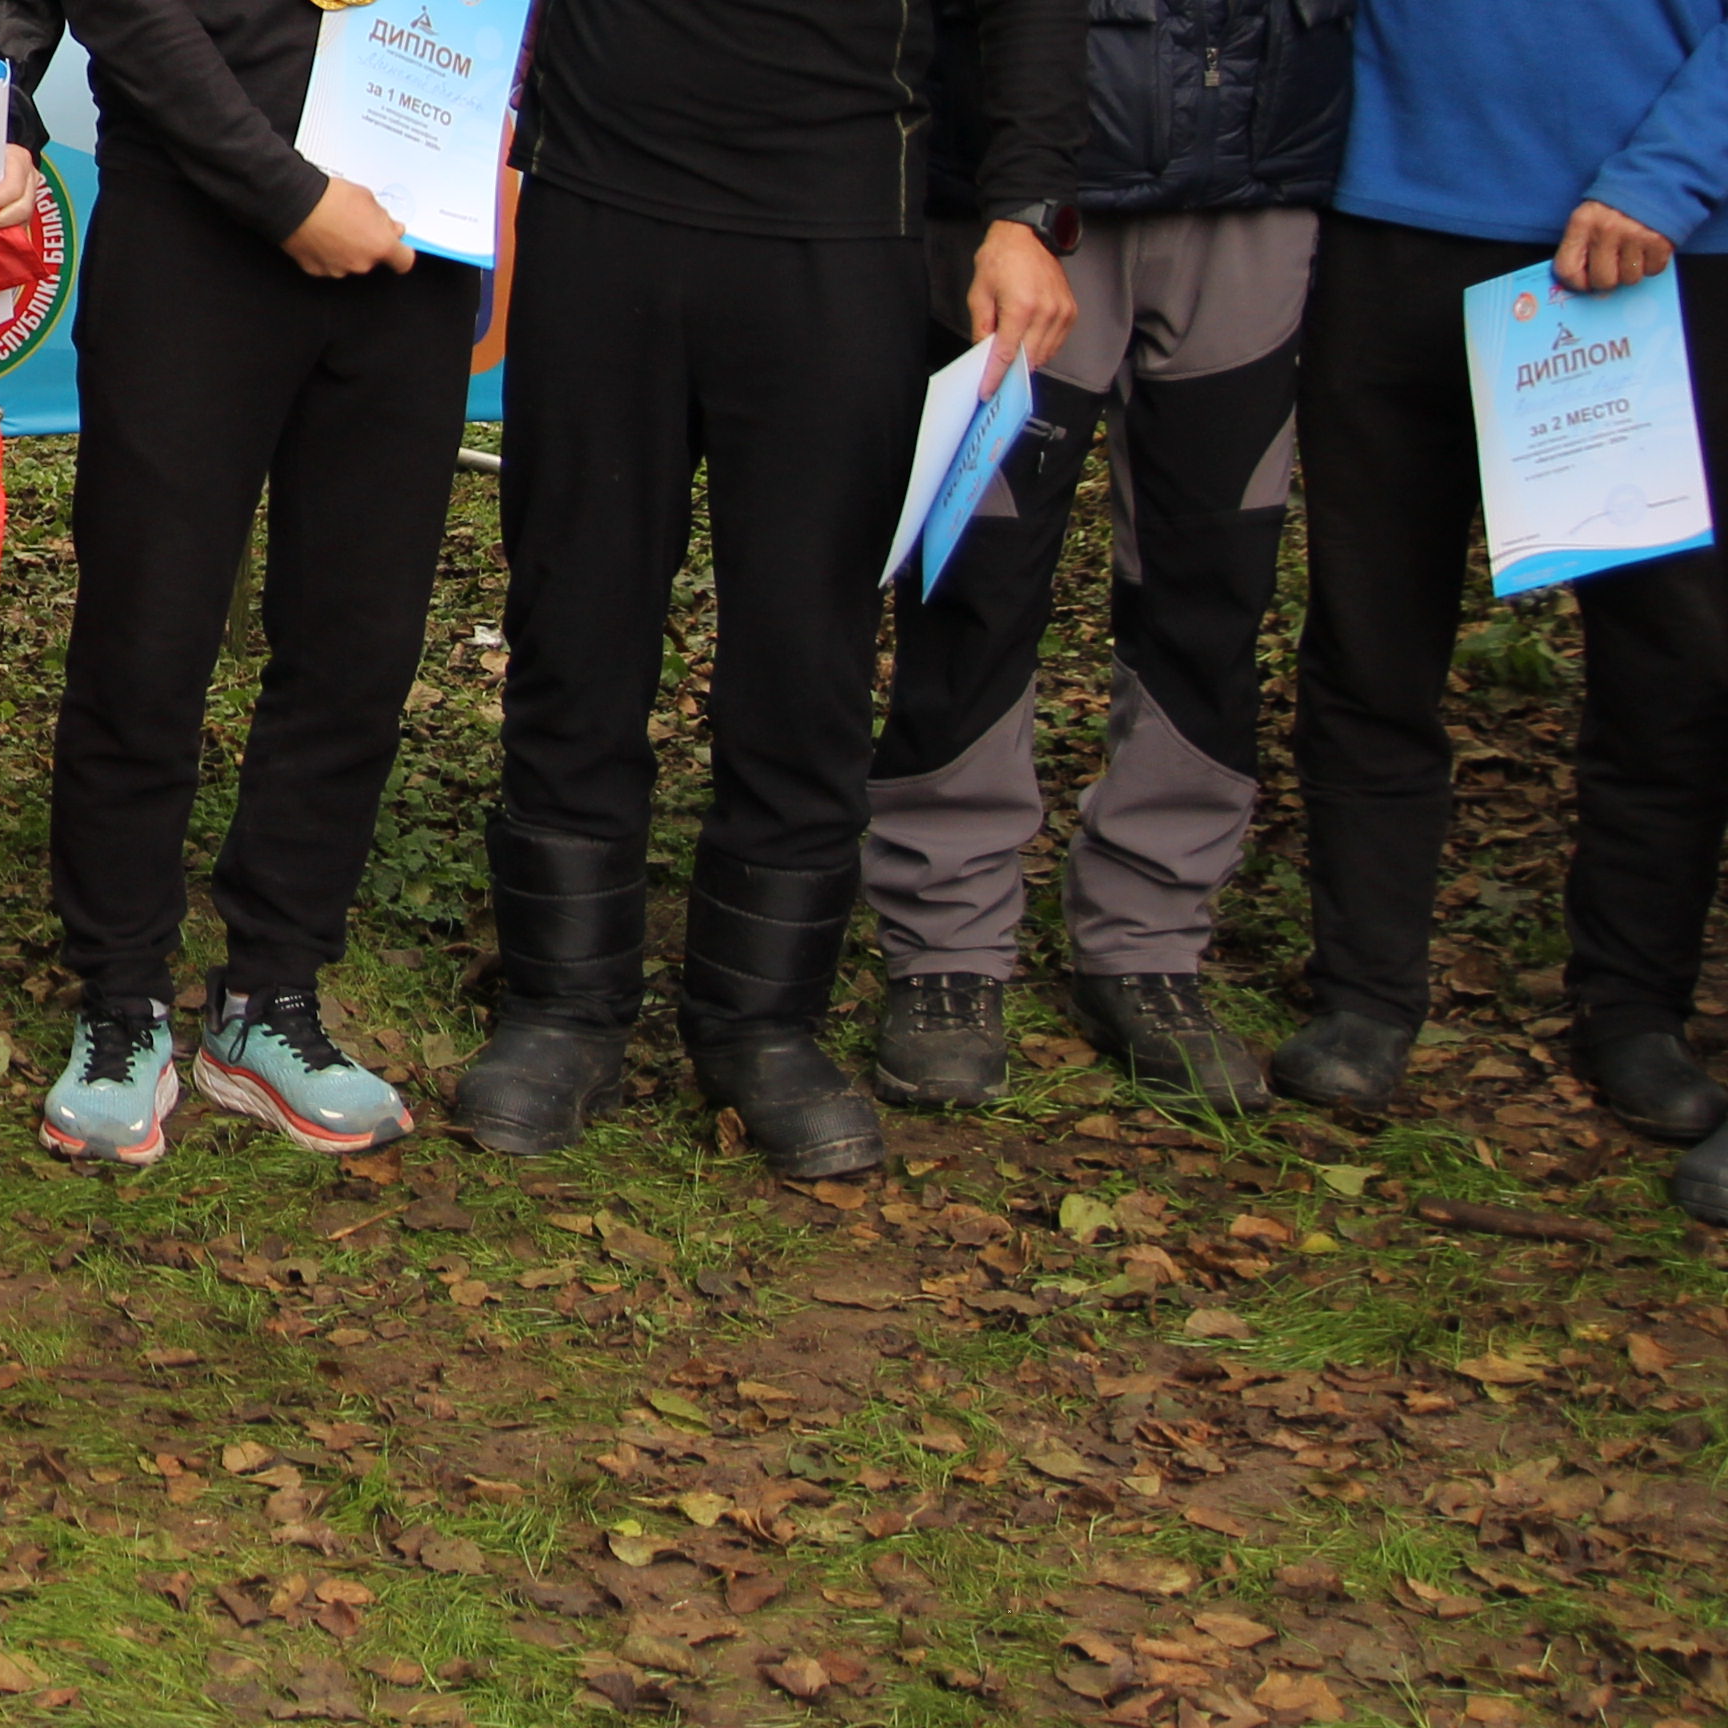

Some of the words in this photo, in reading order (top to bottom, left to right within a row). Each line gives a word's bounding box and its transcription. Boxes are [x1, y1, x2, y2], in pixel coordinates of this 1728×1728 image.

[368, 17, 473, 79] ДИПЛОМ
[365, 81, 383, 98] за
[387, 87, 395, 103] 1
[398, 92, 453, 127] МЕСТО
[1515, 336, 1631, 393] ДИПЛОМ
[1529, 422, 1549, 438] за
[1551, 415, 1562, 431] 2
[1565, 397, 1630, 427] МЕСТО
